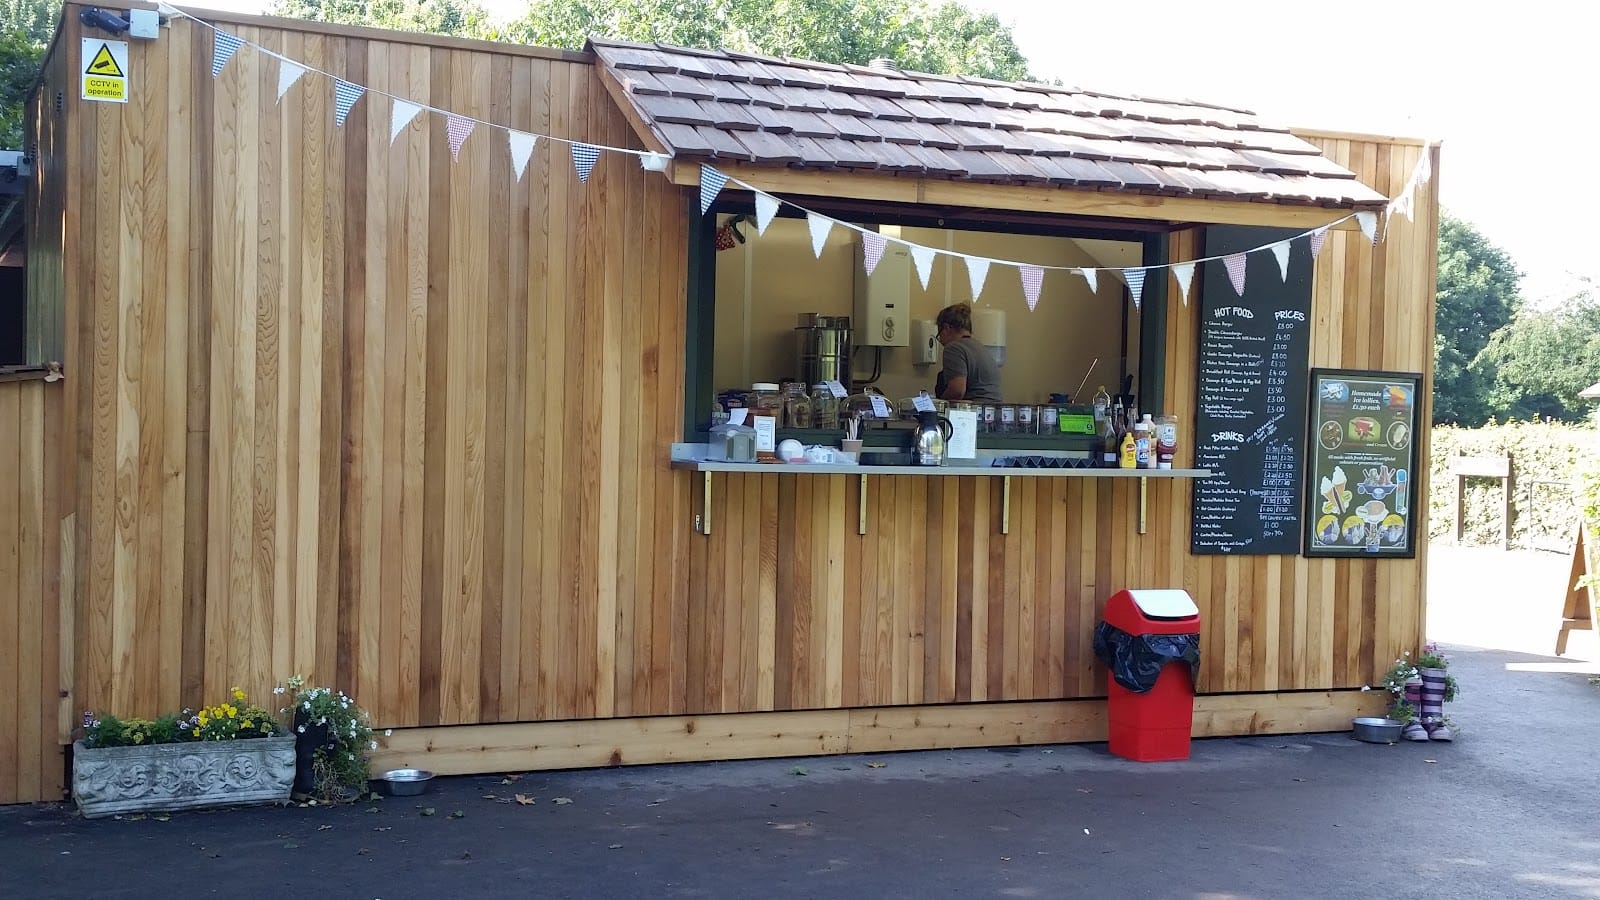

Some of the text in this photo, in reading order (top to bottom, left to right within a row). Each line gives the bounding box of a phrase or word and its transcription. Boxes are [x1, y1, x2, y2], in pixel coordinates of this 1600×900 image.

[1214, 307, 1254, 318] HOT FOOD
[1274, 310, 1305, 321] PRICES
[1211, 431, 1244, 442] DRINKS
